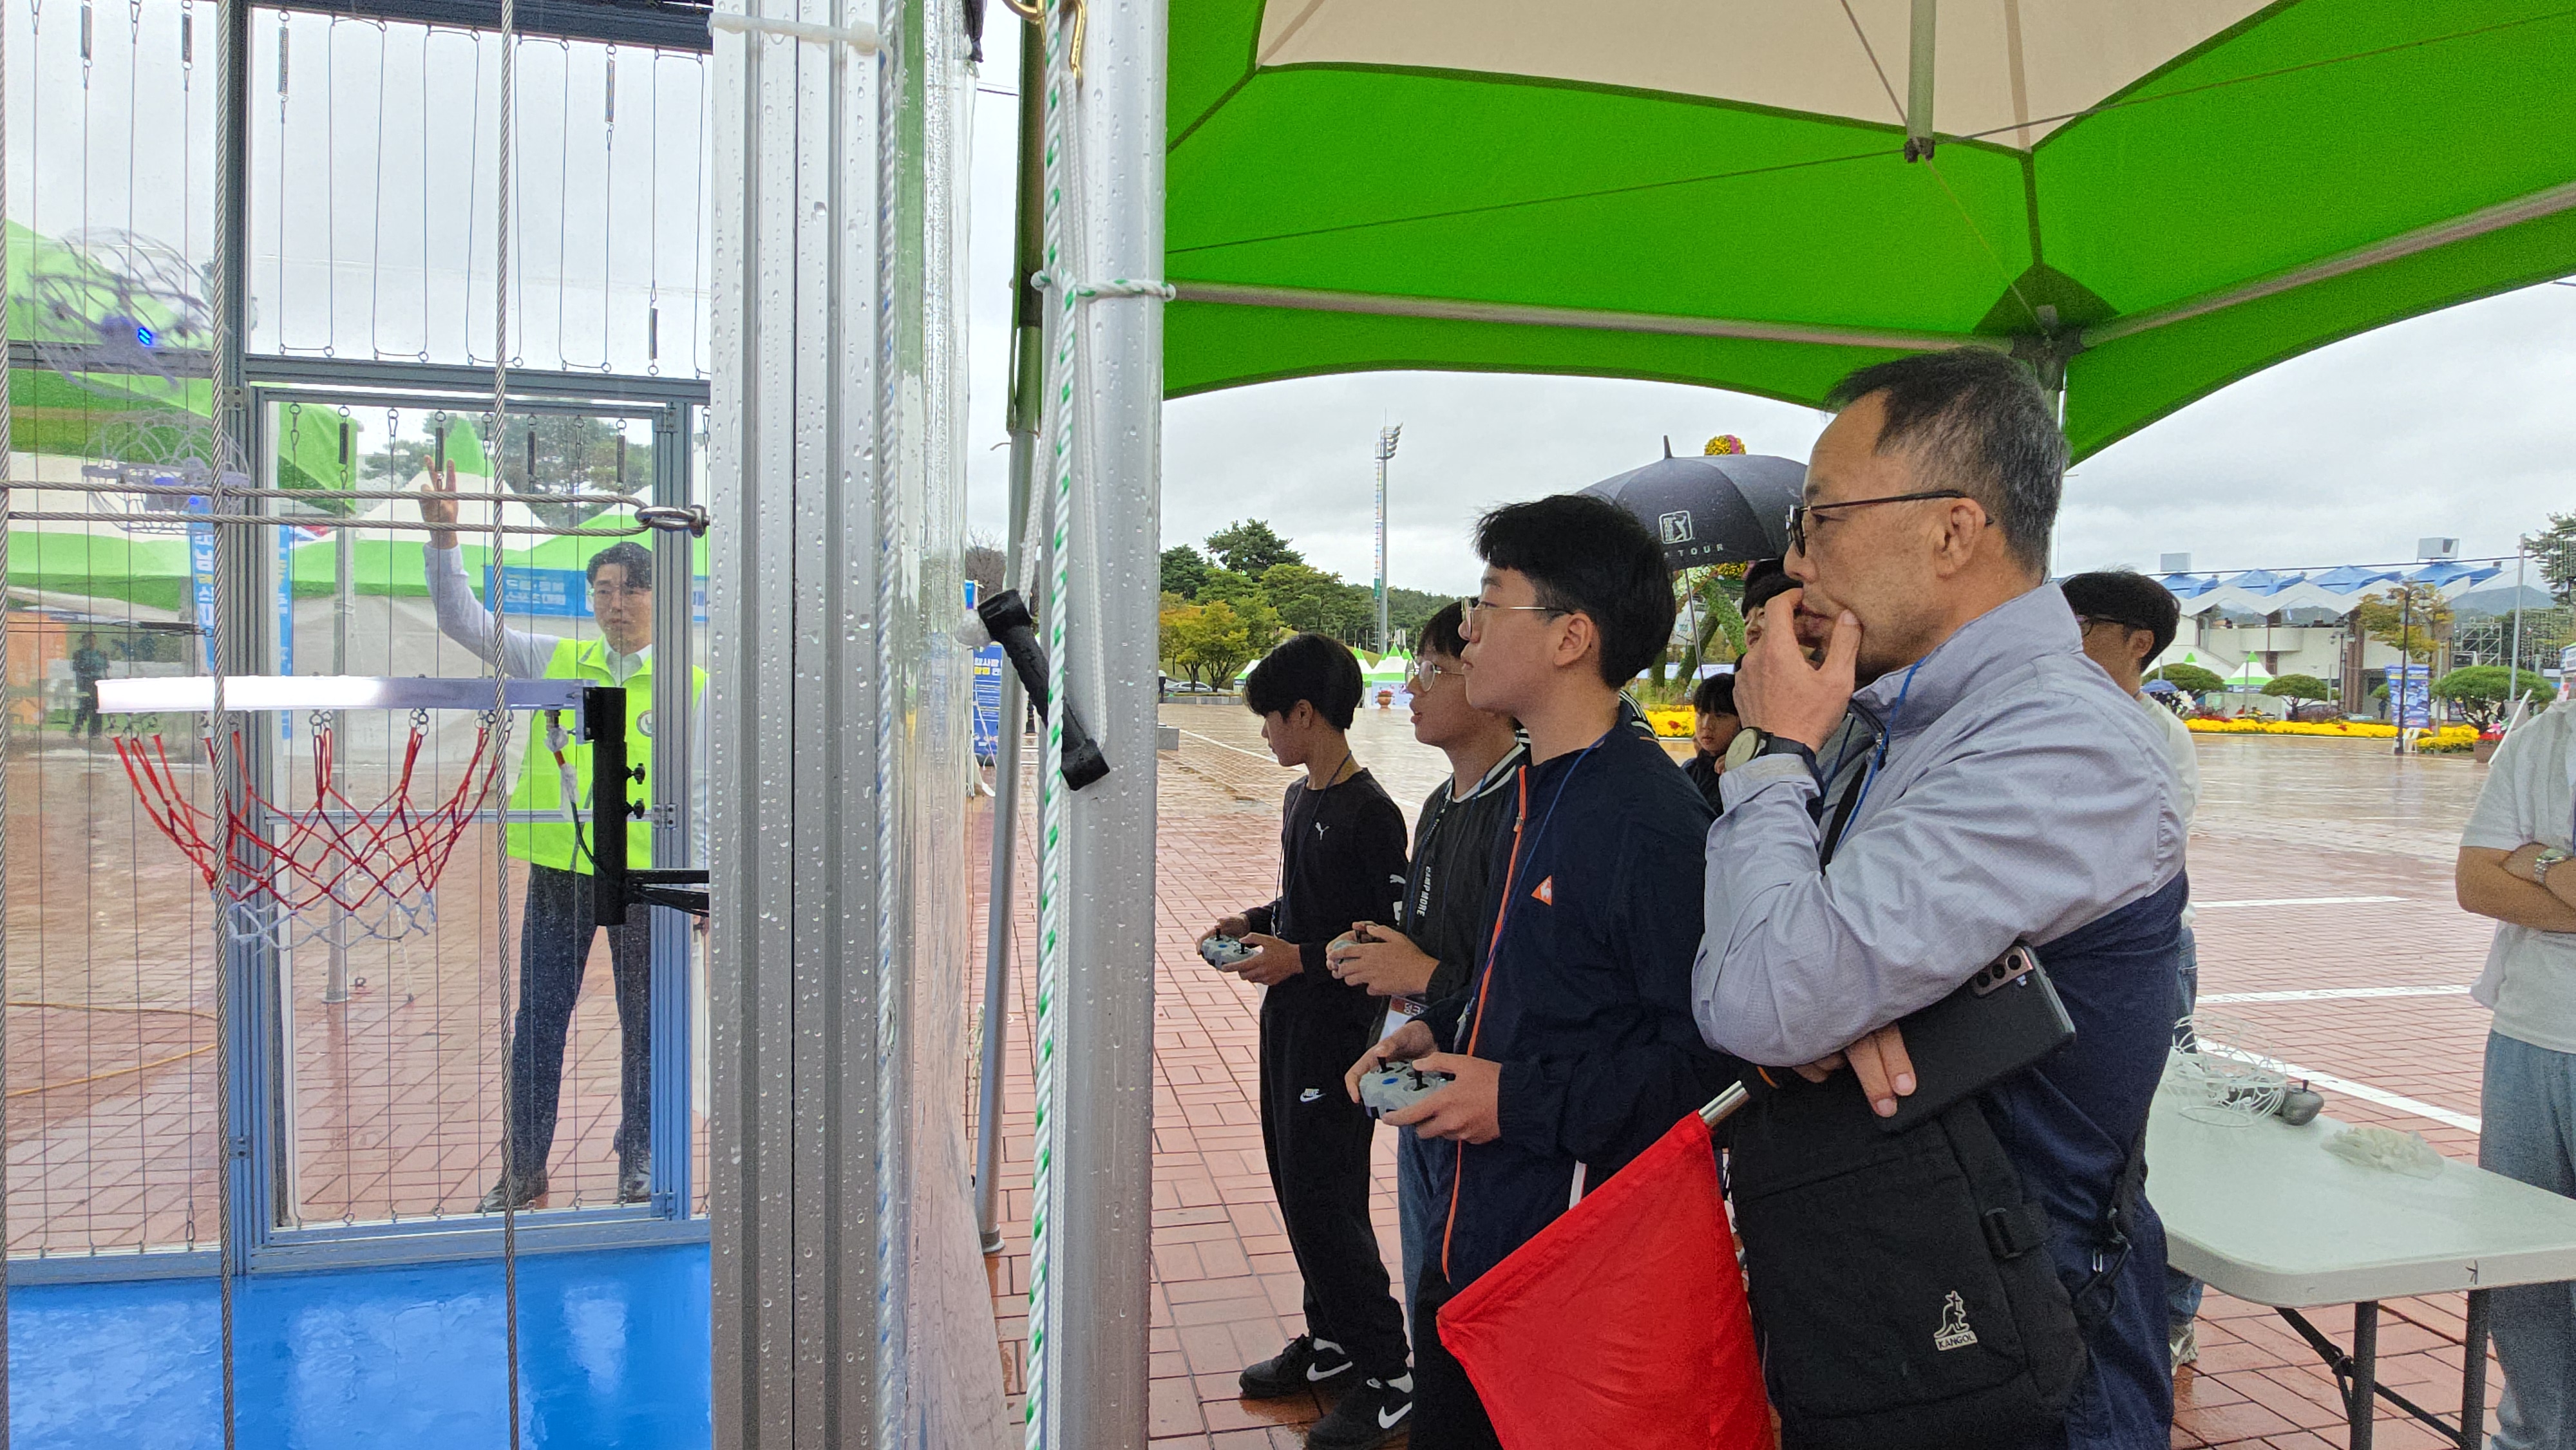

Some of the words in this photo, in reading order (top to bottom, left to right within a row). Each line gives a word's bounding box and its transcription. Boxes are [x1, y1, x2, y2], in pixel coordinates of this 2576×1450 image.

[1678, 543, 1724, 557] TOUR
[1423, 865, 1432, 892] CAMP
[1416, 890, 1429, 917] MORE
[1937, 1333, 1975, 1350] KANGOL
